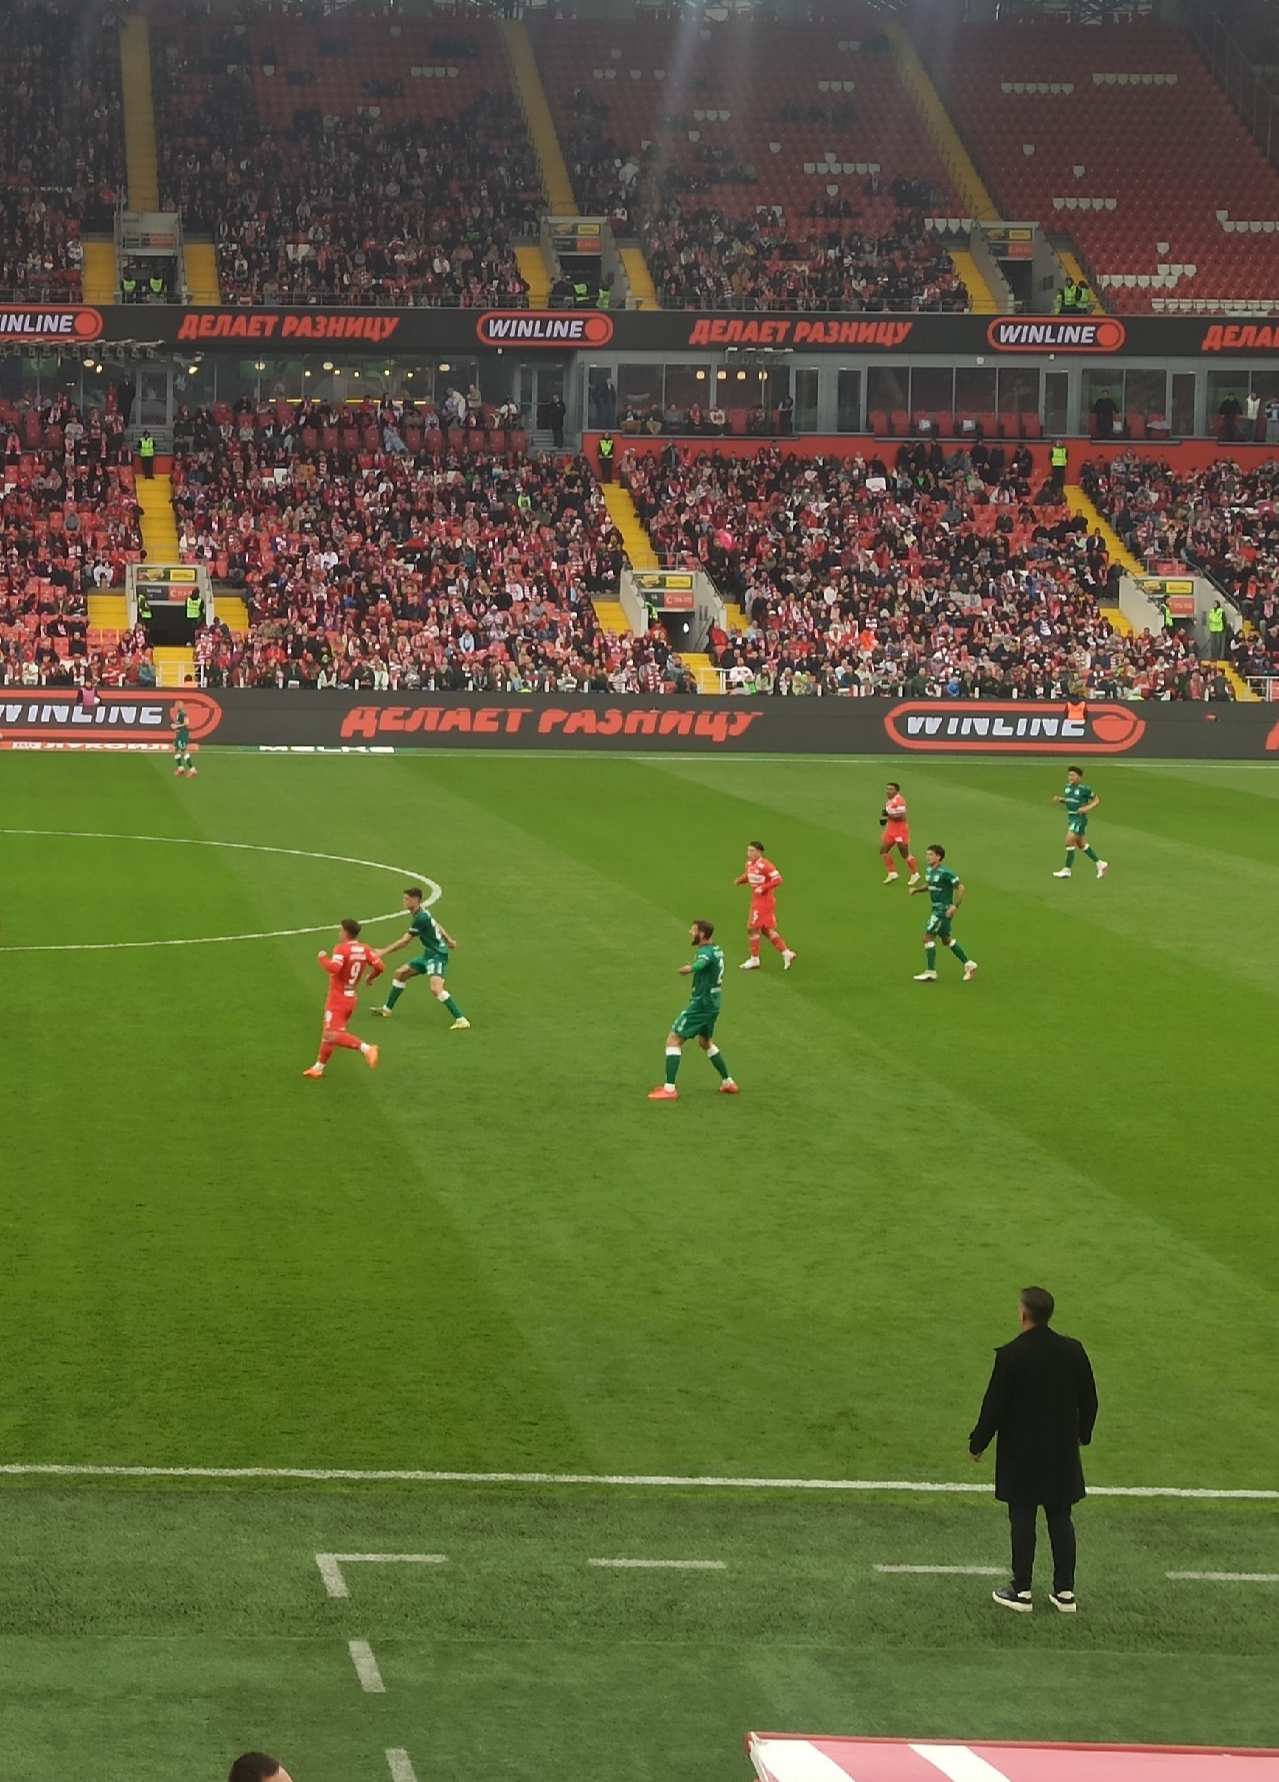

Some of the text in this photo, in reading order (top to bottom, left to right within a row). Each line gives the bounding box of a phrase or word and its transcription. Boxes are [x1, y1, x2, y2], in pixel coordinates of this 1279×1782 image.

[177, 314, 400, 342] ДЕЛАЕТ РАЗНИЦУ
[489, 319, 584, 338] WINLINE
[689, 319, 913, 348] ДЕЛАЕТ РАЗНИЦУ
[1000, 325, 1096, 344] WINLINE
[340, 705, 532, 739] ДЕЛАЕТ
[907, 715, 1086, 737] WINLINE
[42, 741, 171, 751] ЛУКОИЛ
[348, 961, 362, 986] 9
